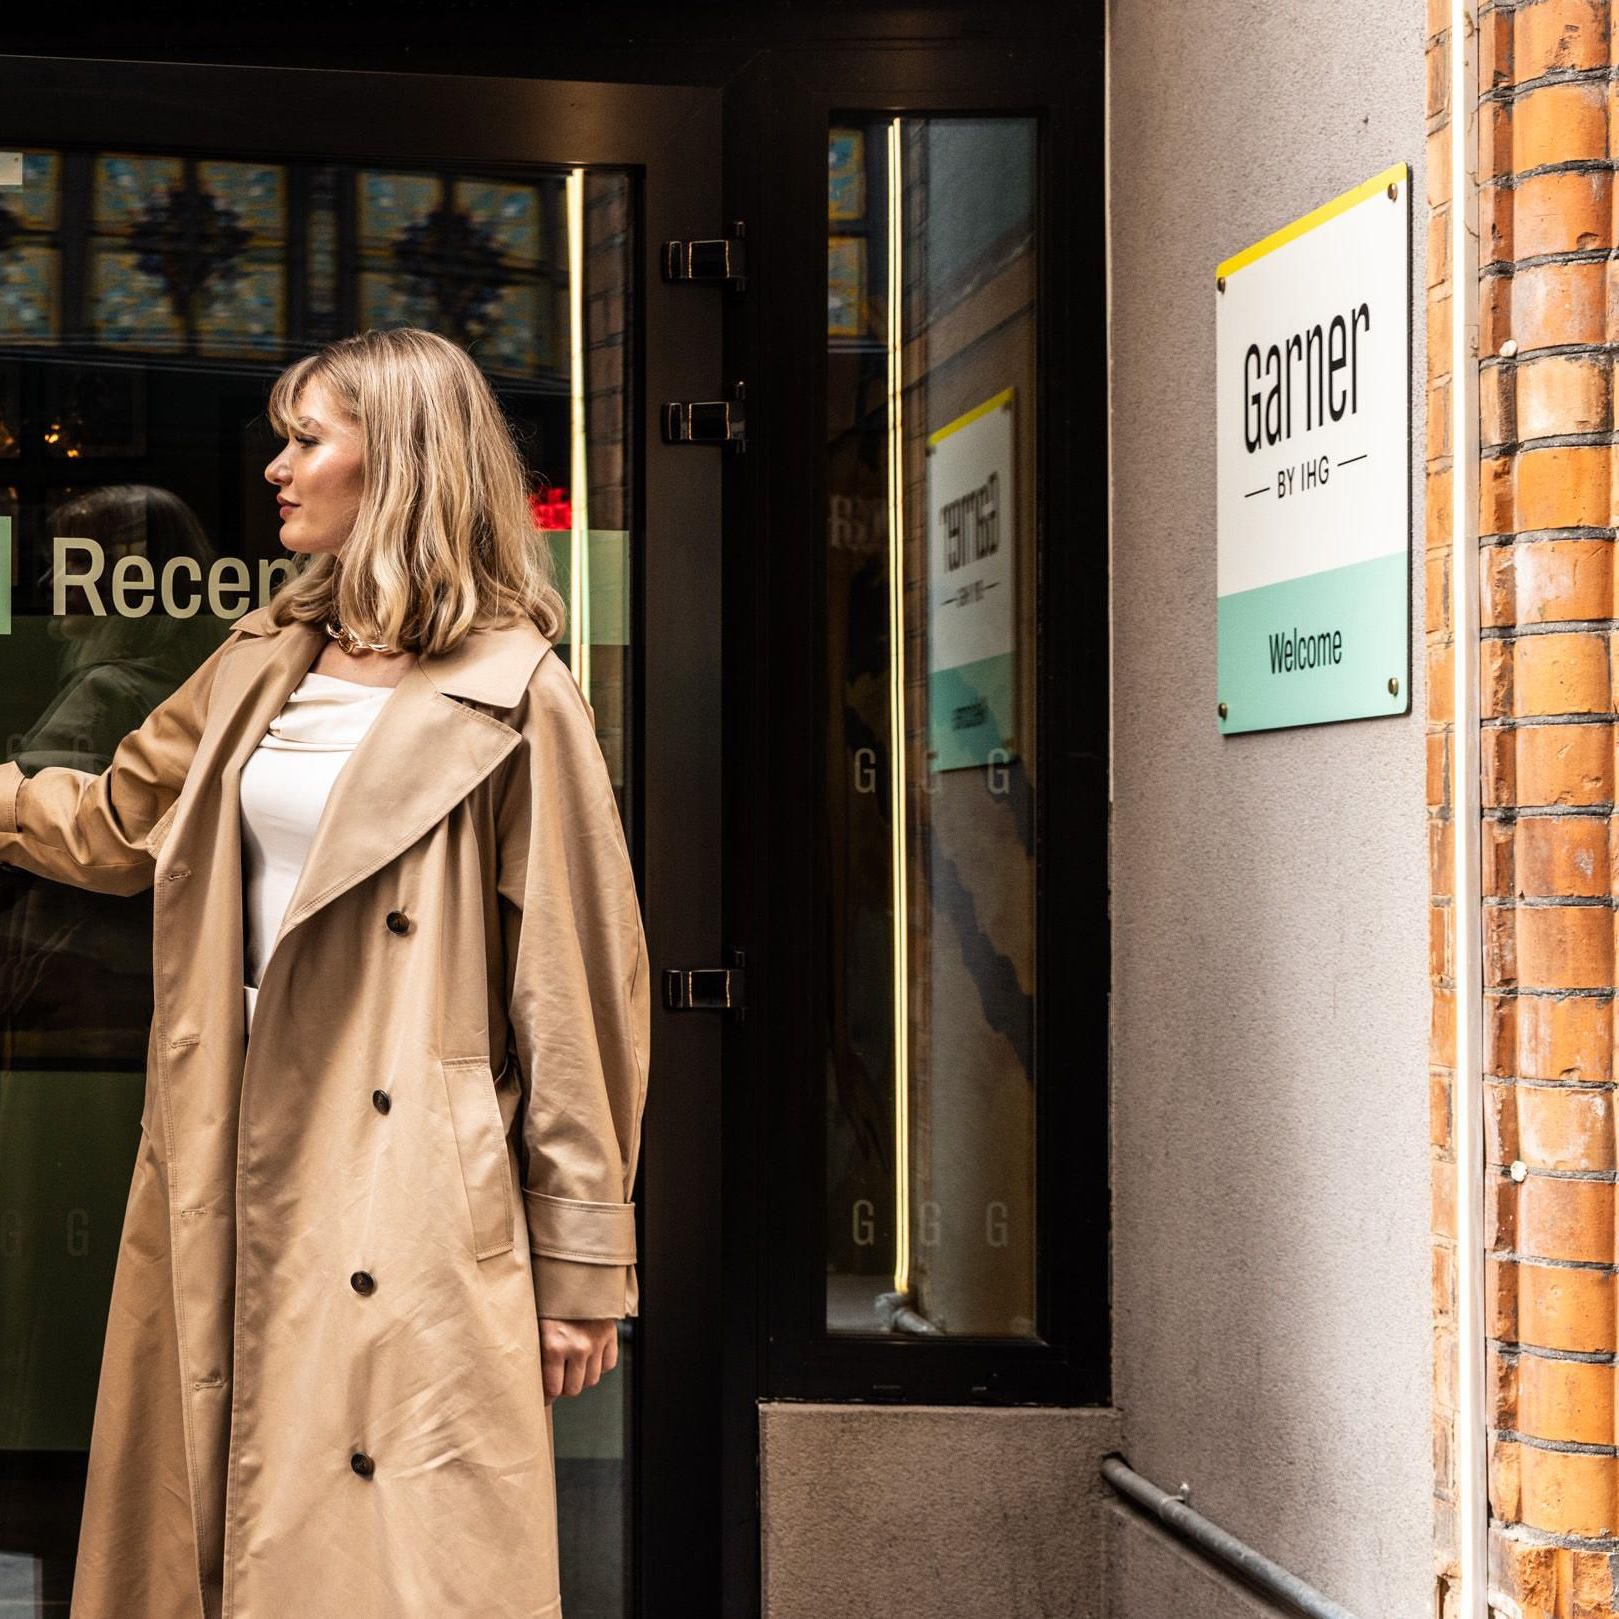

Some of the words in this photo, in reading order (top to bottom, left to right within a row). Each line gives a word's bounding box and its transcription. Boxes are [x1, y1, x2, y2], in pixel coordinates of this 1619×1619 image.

[1244, 303, 1370, 453] Garner
[1278, 467, 1295, 499] BY
[1302, 456, 1329, 492] IHG
[1269, 627, 1342, 675] Welcome
[854, 748, 876, 794] G
[987, 748, 1009, 795] G
[852, 1199, 875, 1246] G
[986, 1201, 1008, 1247] G
